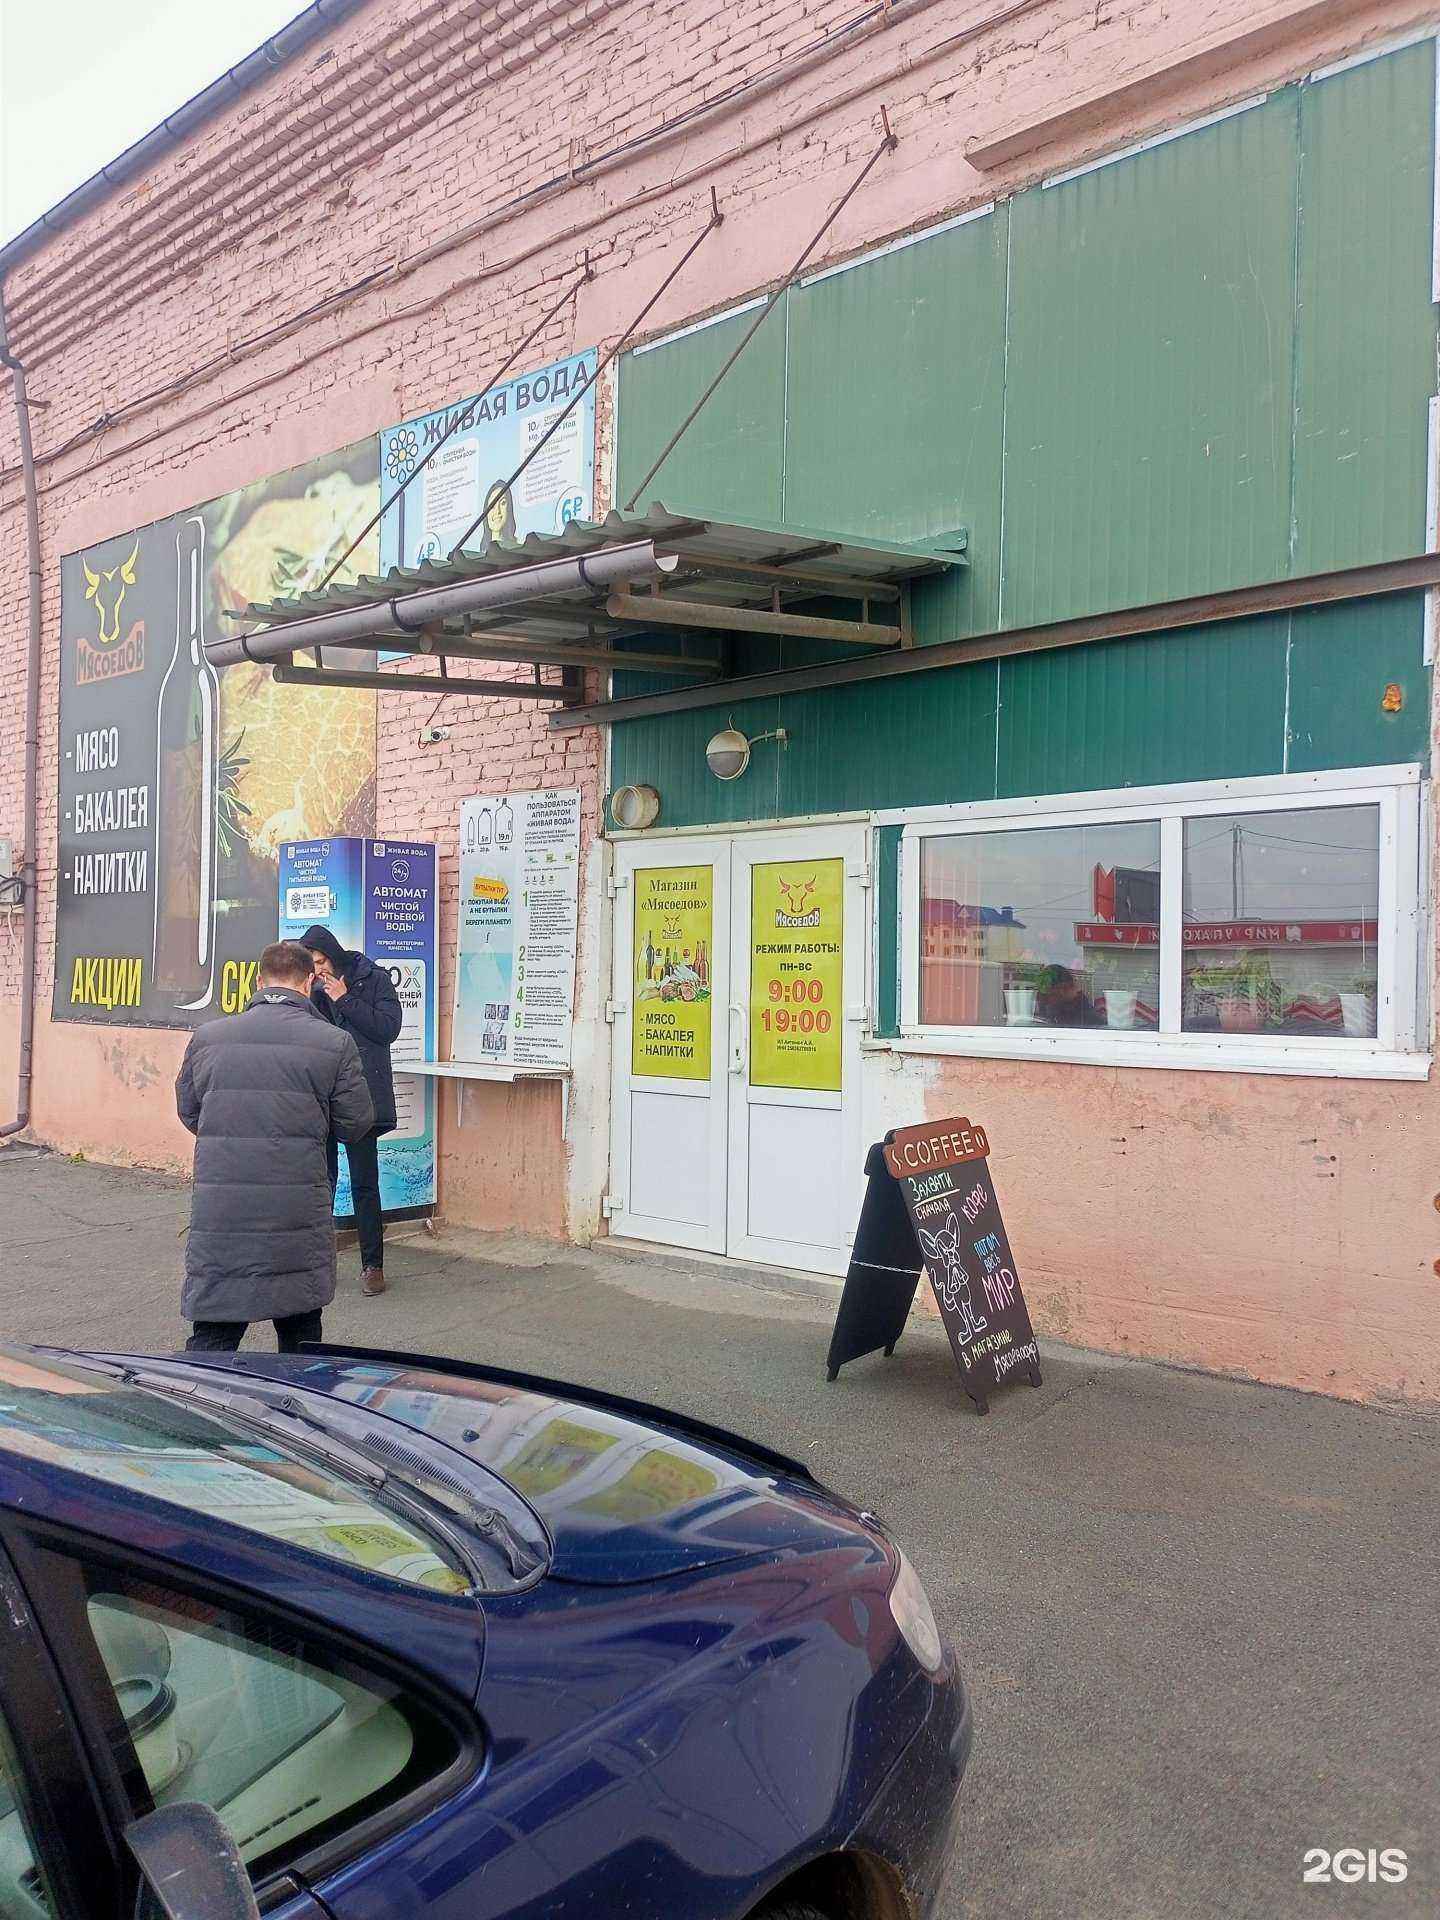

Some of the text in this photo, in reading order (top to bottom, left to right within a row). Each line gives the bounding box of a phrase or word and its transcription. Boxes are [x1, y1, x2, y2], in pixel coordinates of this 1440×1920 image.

[423, 361, 589, 446] ЖИВАЯ ВОДА
[75, 726, 119, 774] МЯСО
[545, 792, 558, 800] КАК
[74, 785, 149, 834] БАКАЛЕЯ
[527, 799, 576, 810] ПОЛЬЗОВАТЬСЯ
[531, 809, 571, 818] АППАРАТОМ
[293, 859, 323, 869] АВТОМАТ
[73, 850, 147, 896] НАПИТКИ
[373, 886, 428, 899] АВТОМАТ
[650, 879, 697, 892] Магазин
[381, 901, 419, 911] ЧИСТОЙ
[641, 898, 708, 911] «Мясоедов»
[375, 911, 425, 921] ПИТЬЕВОЙ
[386, 922, 414, 932] ВОДЫ
[519, 945, 525, 961] 2
[755, 943, 840, 954] РЕЖИМ РАБОТЫ:
[519, 966, 524, 981] 3
[71, 958, 142, 1011] АКЦИИ
[222, 960, 260, 1013] СК
[768, 980, 823, 1003] 9:00
[517, 986, 523, 1002] 4
[515, 1012, 521, 1028] 5
[645, 1013, 675, 1025] МЯСО
[761, 1009, 832, 1033] 19:00
[645, 1029, 694, 1042] БАКАЛЕЯ
[645, 1044, 694, 1058] НАПИТКИ
[904, 1131, 974, 1167] COFFEE
[982, 1269, 1014, 1312] МИР
